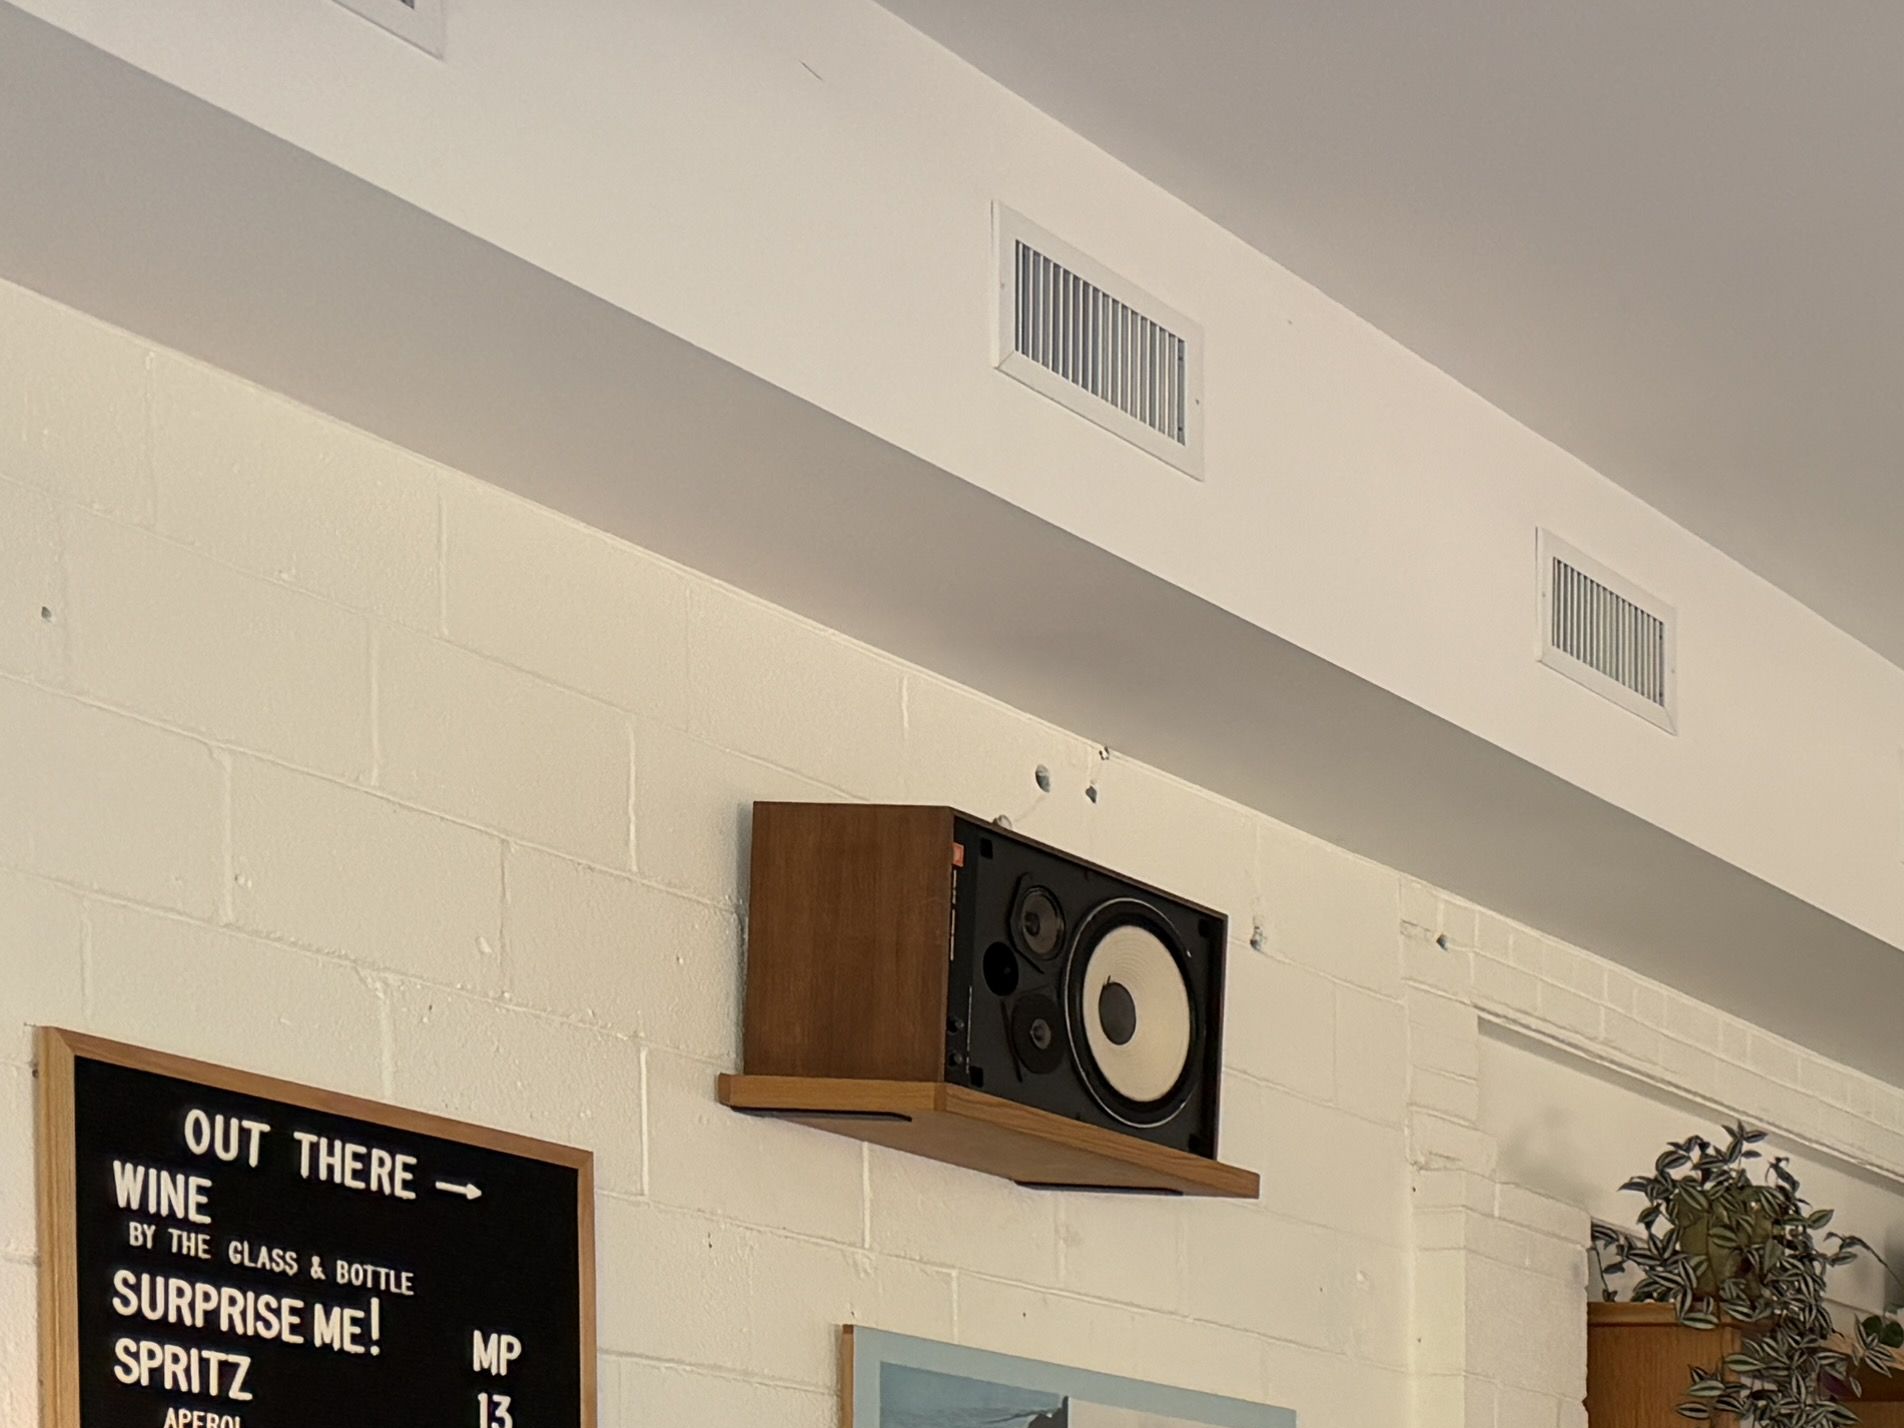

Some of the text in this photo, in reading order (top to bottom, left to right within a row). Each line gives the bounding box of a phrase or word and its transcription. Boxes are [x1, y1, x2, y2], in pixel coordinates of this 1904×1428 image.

[184, 1108, 418, 1200] OUT THERE
[113, 1160, 212, 1225] WINE
[129, 1221, 415, 1296] BY THE GLASS & BOTTLE
[112, 1269, 381, 1357] SURPRISE ME!
[113, 1337, 253, 1401] SPRITZ
[472, 1329, 522, 1376] MP
